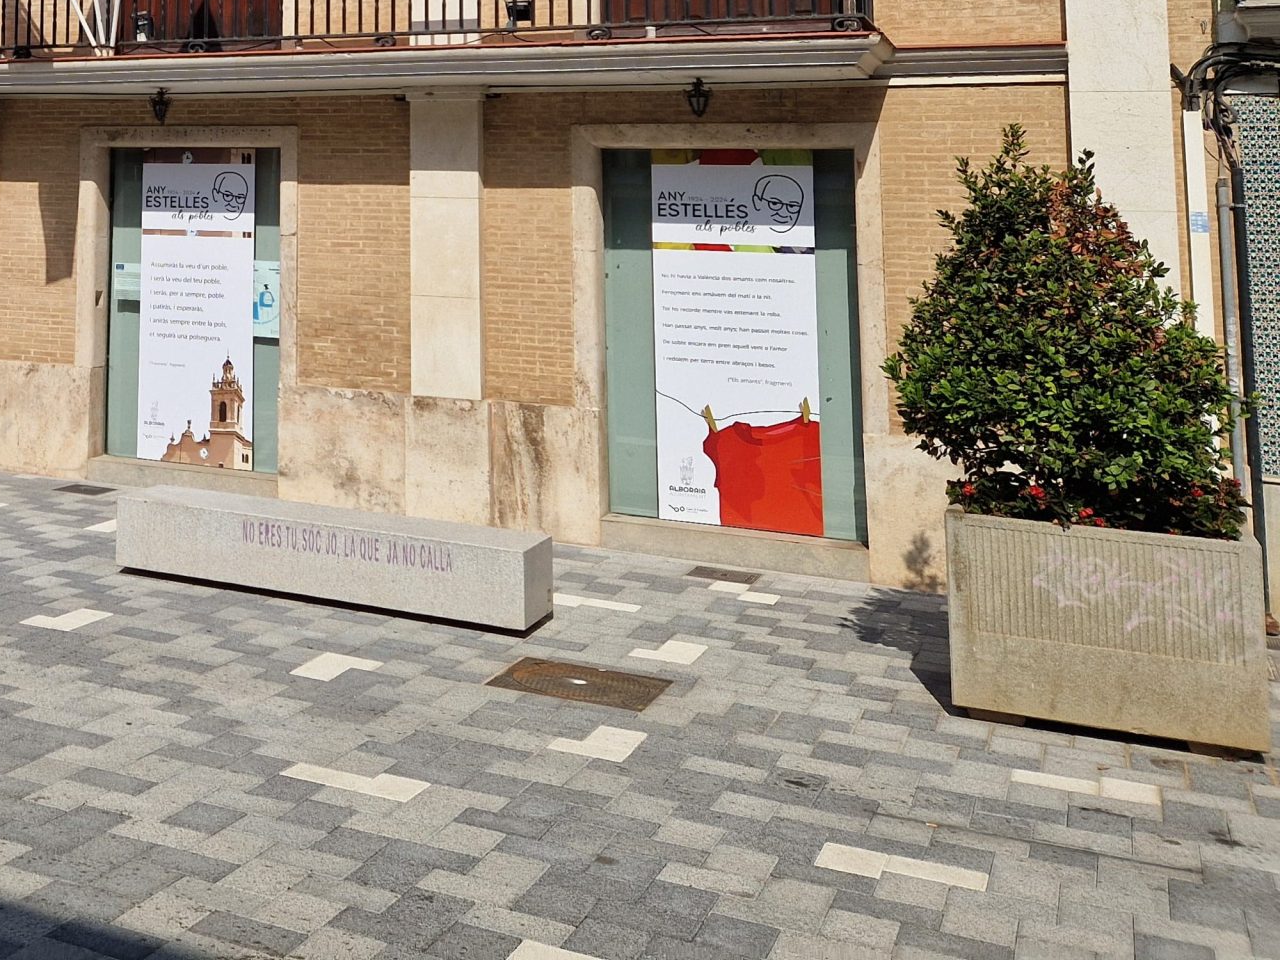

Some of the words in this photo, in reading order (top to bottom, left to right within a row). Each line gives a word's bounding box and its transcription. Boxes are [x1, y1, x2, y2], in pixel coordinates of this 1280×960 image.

[146, 186, 166, 194] ANY
[658, 191, 686, 201] ANY
[145, 191, 209, 209] ESTELLÉS
[172, 209, 184, 220] als
[188, 210, 214, 223] pobles
[657, 198, 749, 219] ESTELLÉS
[696, 219, 713, 232] als
[720, 220, 757, 237] pobles
[668, 485, 706, 494] ALBORAIA
[242, 520, 255, 544] NO
[258, 522, 282, 548] ERES
[326, 531, 340, 558] JO,
[344, 535, 356, 558] LA
[359, 536, 380, 562] QUE
[387, 540, 398, 566] JA
[402, 543, 416, 567] NO
[420, 543, 453, 573] CALLA
